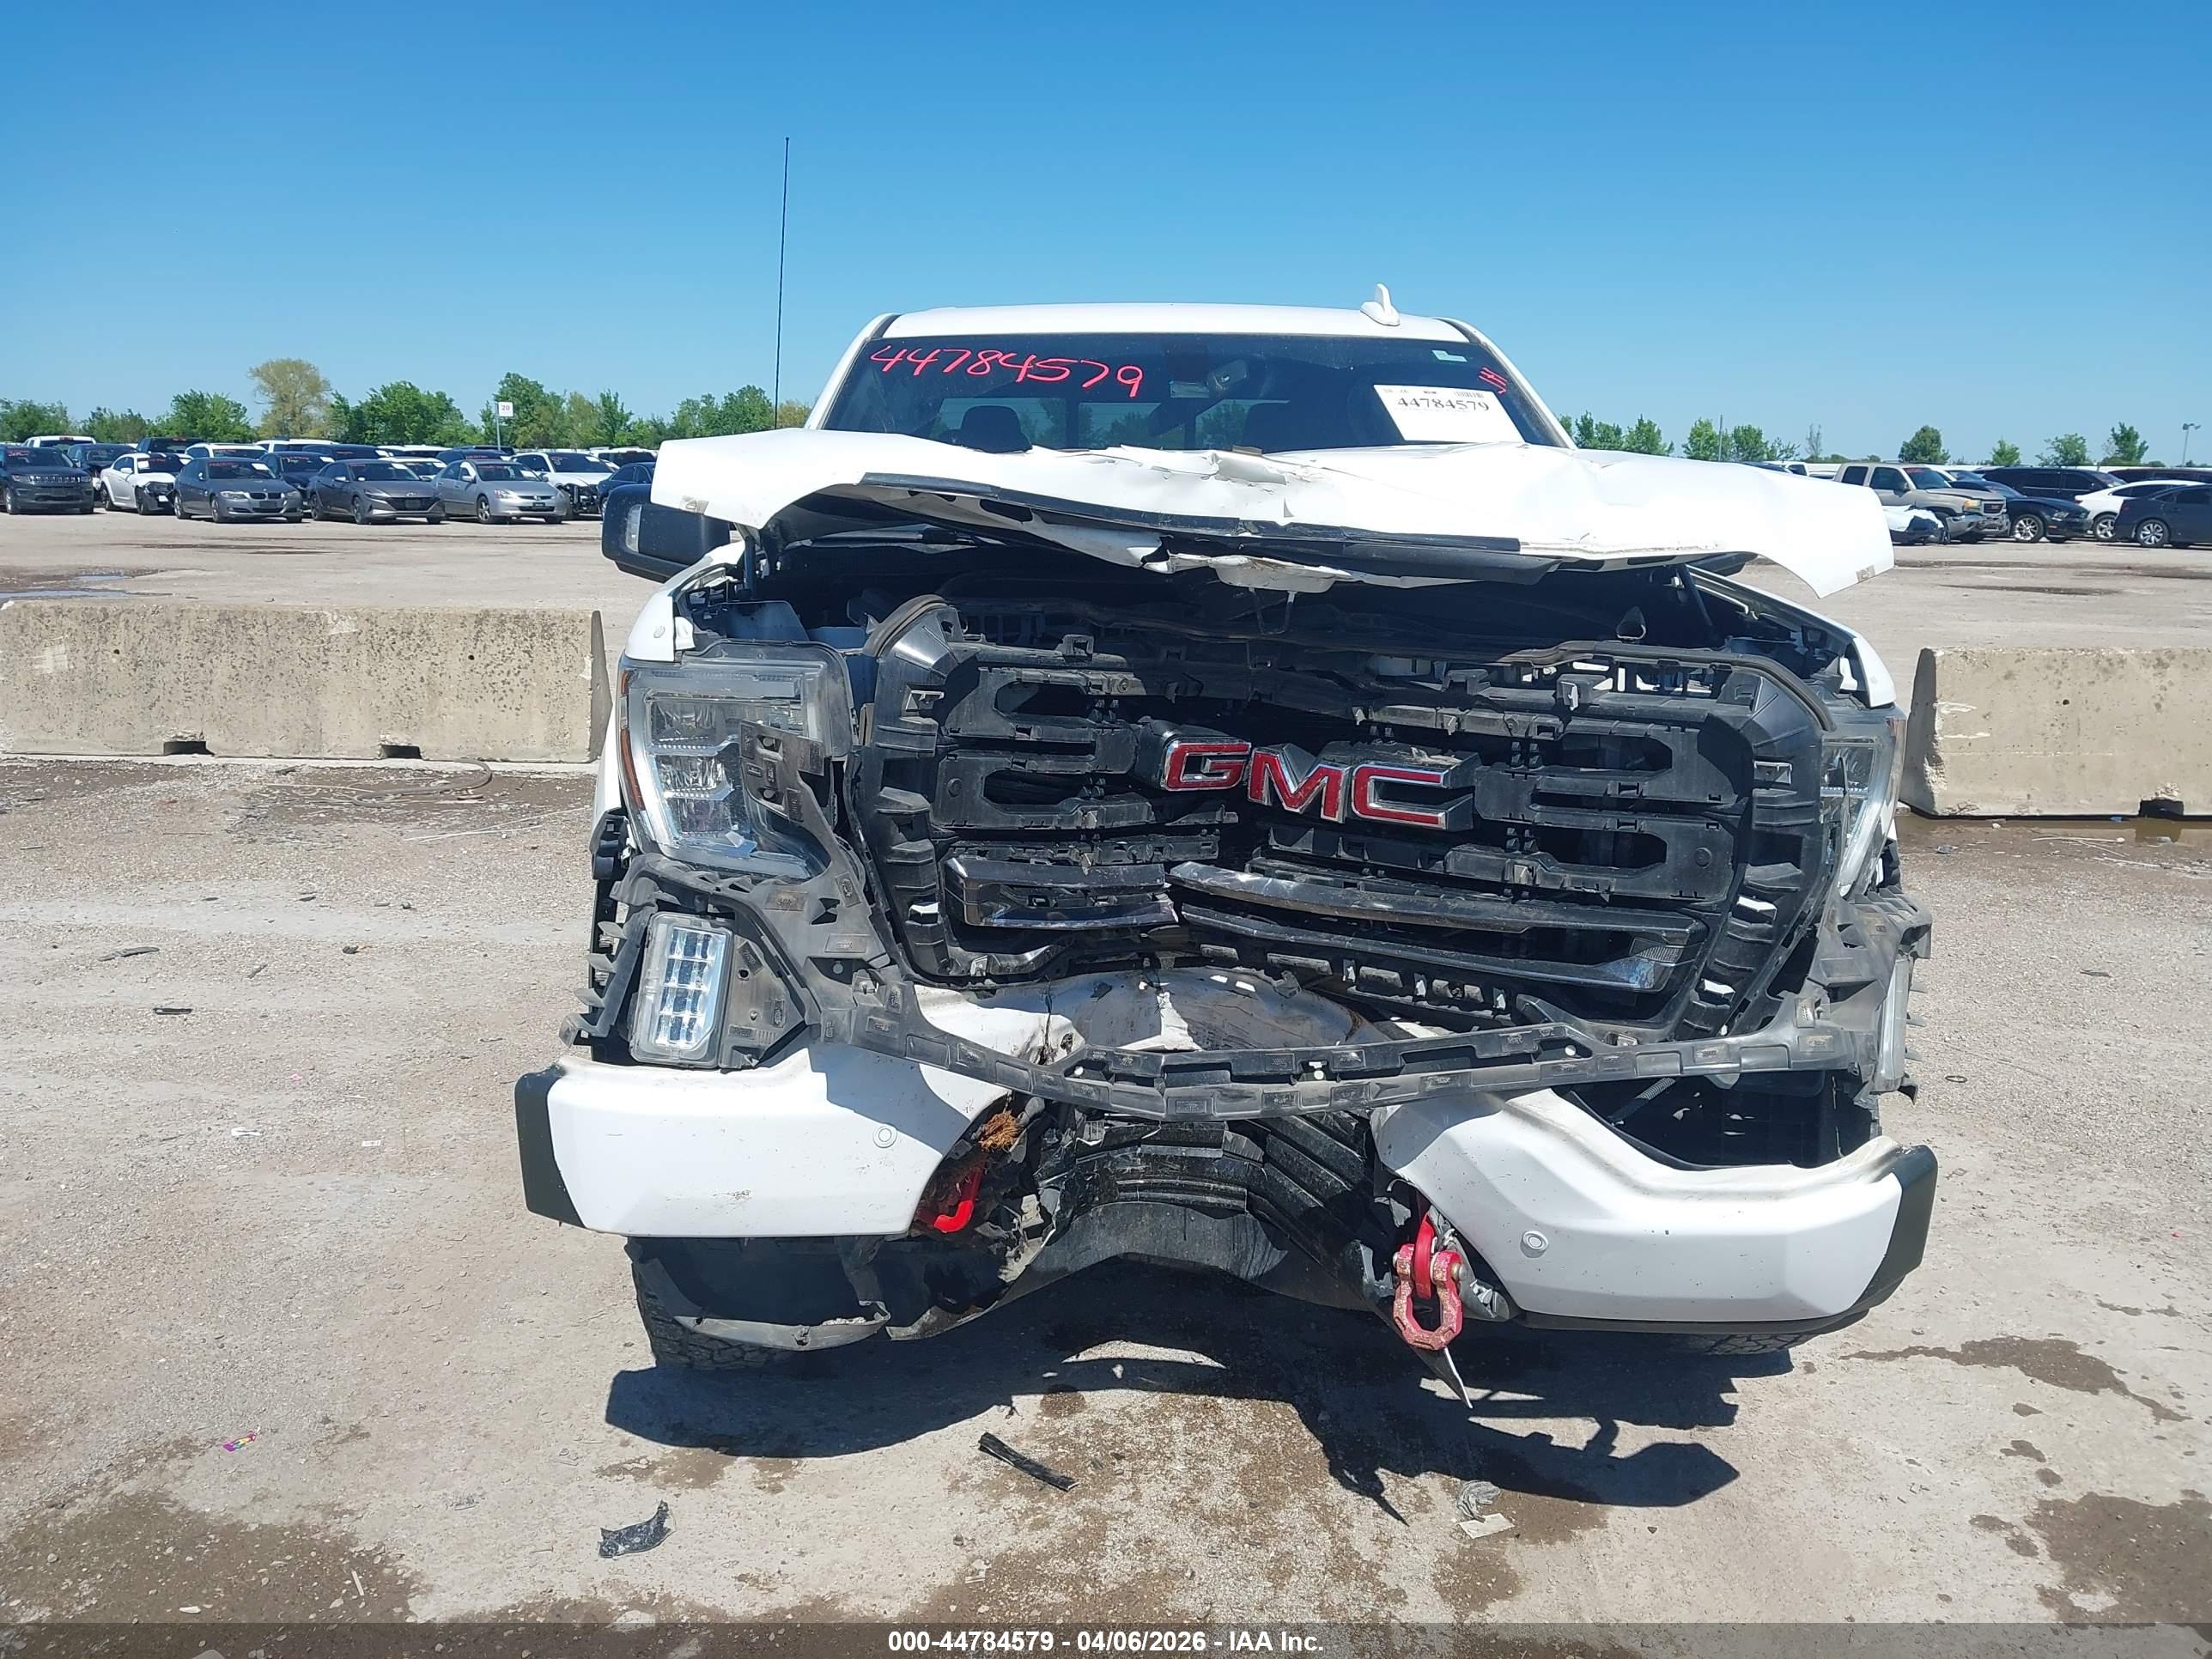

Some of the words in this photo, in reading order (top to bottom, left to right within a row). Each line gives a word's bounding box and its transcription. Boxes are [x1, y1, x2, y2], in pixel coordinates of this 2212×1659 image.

[870, 345, 1143, 398] 44784579
[1398, 398, 1490, 410] 44784579
[1162, 739, 1451, 830] GMC
